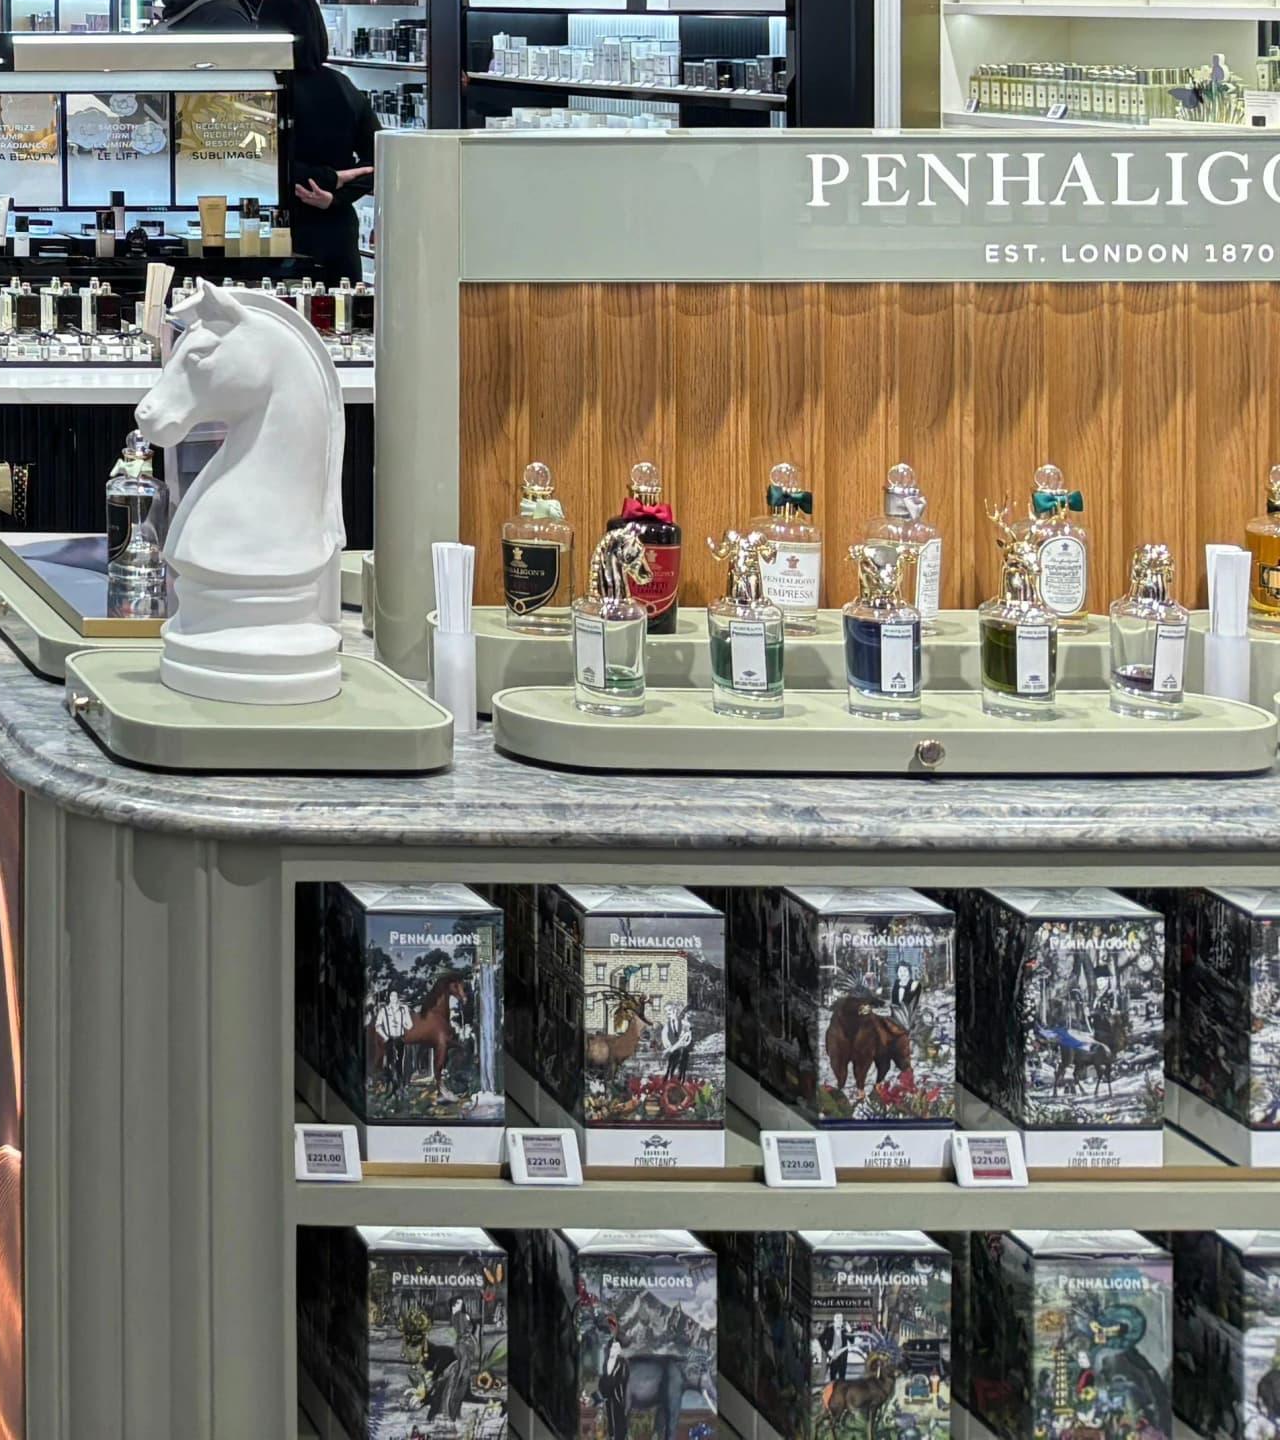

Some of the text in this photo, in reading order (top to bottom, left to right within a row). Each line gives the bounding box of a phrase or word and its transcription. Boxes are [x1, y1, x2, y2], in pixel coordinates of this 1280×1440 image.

[9, 152, 56, 161] BEAUTY
[97, 152, 139, 161] LE LIFT
[192, 151, 262, 160] SUBLIMAGE
[985, 244, 1275, 263] EST. LONDON 1870
[767, 587, 815, 600] EMPRESSA
[389, 930, 481, 946] PENHALIGON'S
[609, 933, 702, 948] PENHALIGON'S
[391, 1271, 484, 1287] PENHALIGON'S
[601, 1273, 694, 1288] PENHALIGON'S
